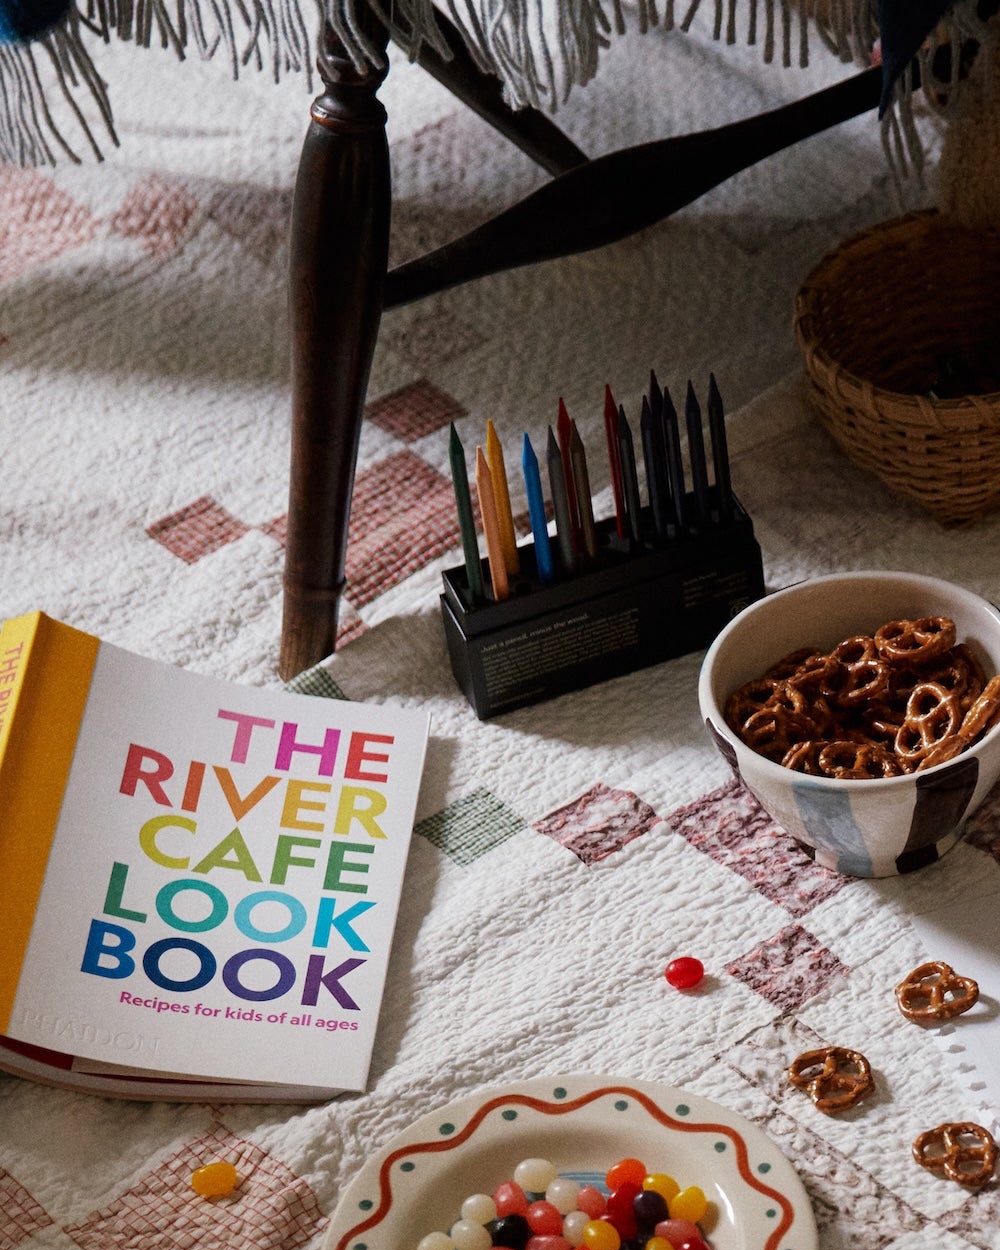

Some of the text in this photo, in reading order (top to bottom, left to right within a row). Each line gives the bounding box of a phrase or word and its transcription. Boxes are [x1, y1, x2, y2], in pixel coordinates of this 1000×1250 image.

[217, 709, 395, 783] THE
[119, 743, 388, 840] RIVER
[138, 814, 376, 894] CAFE
[102, 861, 377, 953] LOOK
[80, 918, 368, 1011] BOOK
[119, 991, 360, 1034] Recipes for kids of all ages
